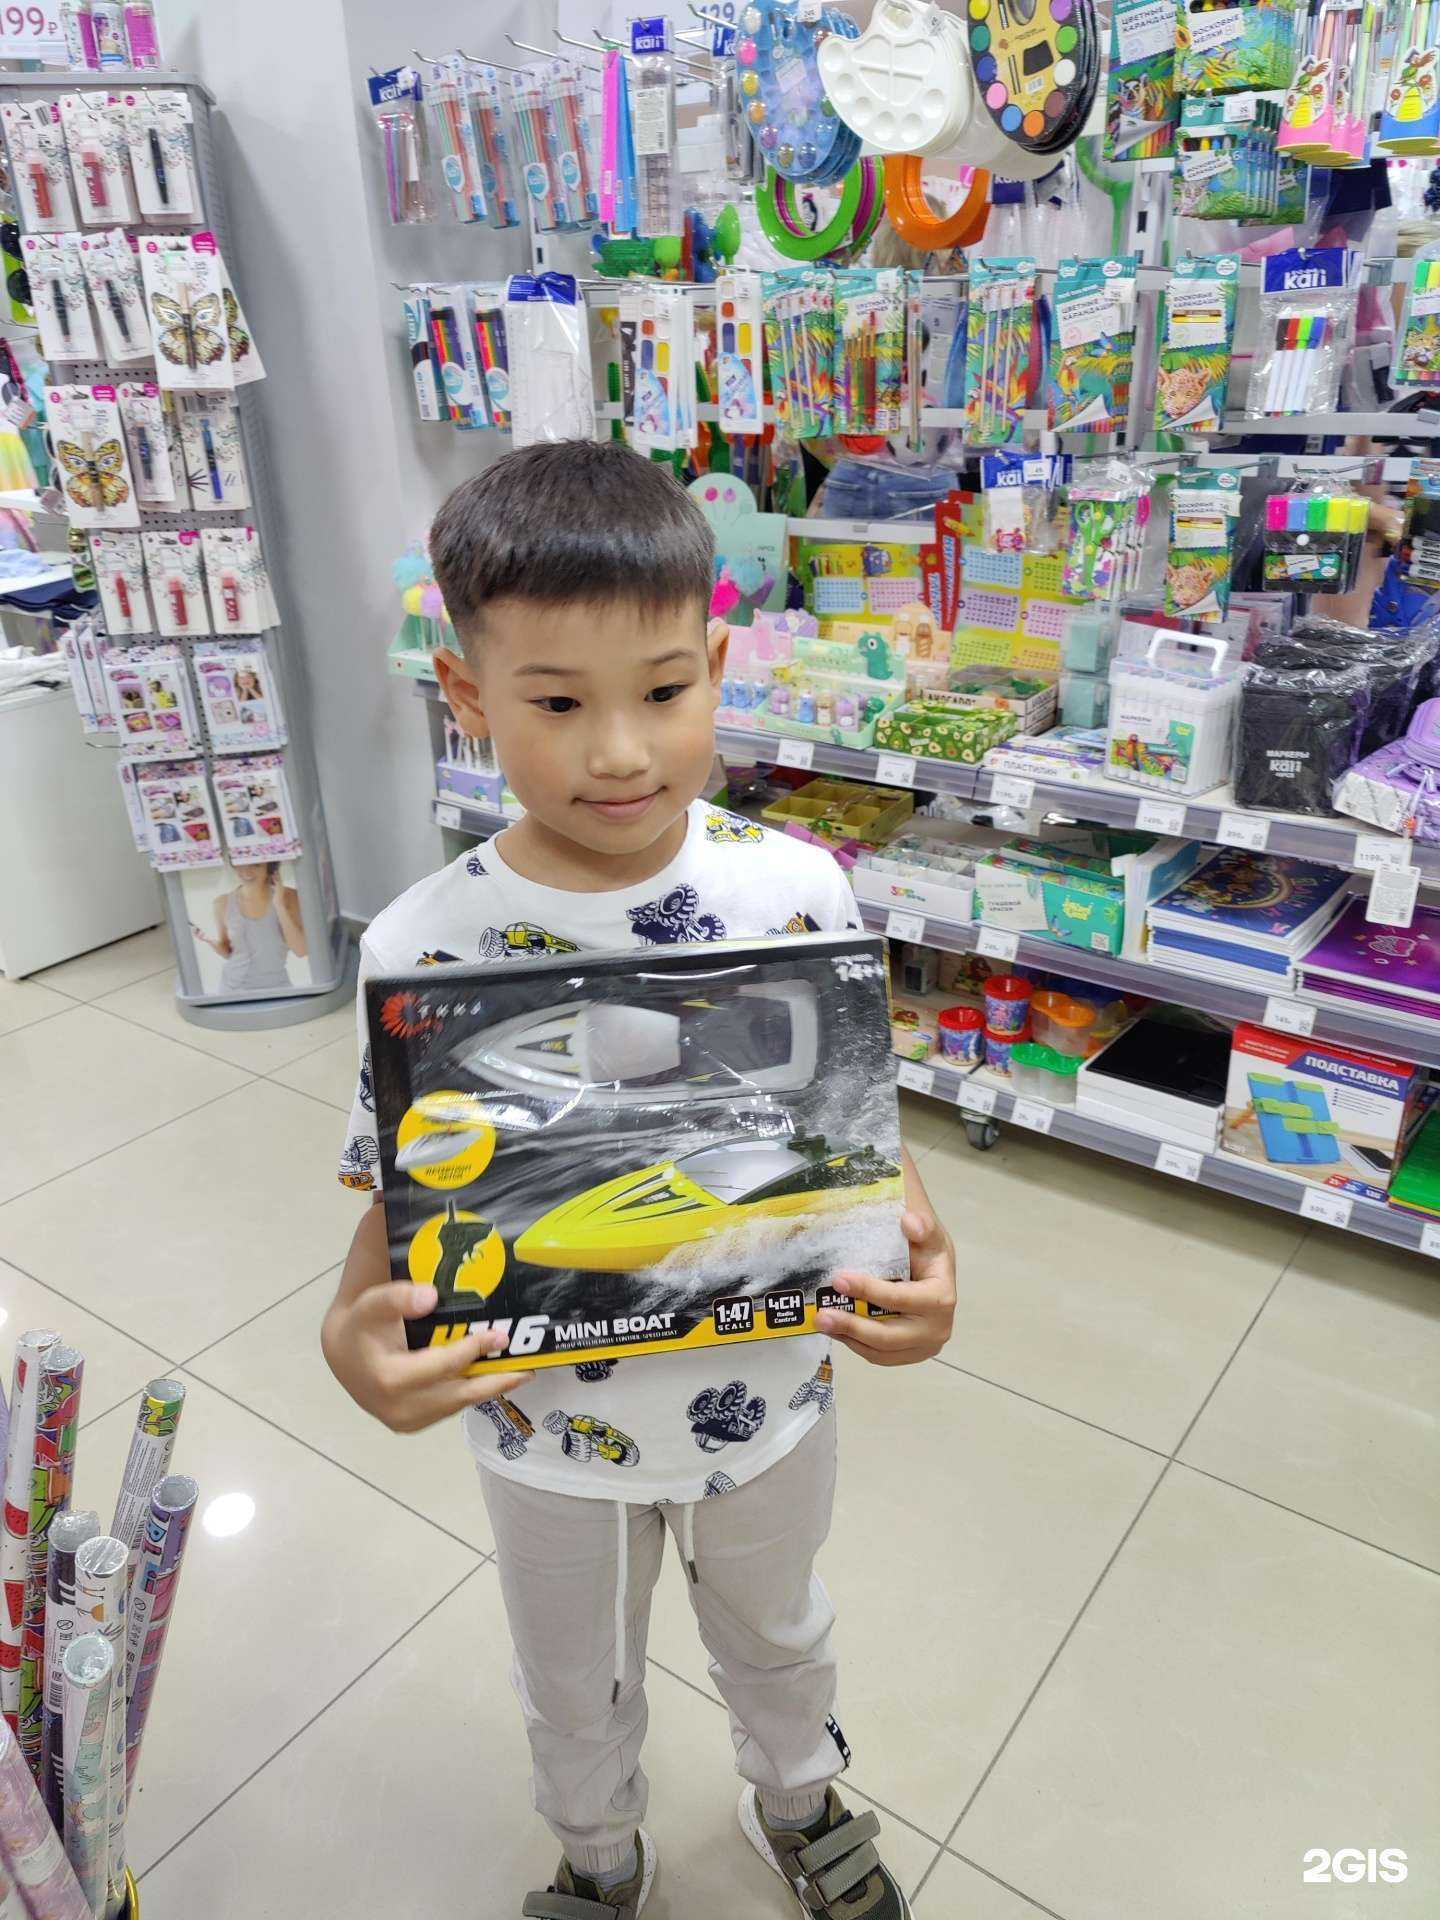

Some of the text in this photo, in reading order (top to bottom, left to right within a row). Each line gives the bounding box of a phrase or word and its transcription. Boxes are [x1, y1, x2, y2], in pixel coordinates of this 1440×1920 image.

[1121, 6, 1164, 25] ЦВЕТНЫЕ
[1123, 11, 1176, 32] КАРАНДАШ
[1193, 14, 1239, 37] ВОСКОВЫЕ
[1284, 268, 1327, 290] kari
[1003, 760, 1057, 777] ПЛАСТИЛИН
[1304, 1055, 1400, 1092] ПОДСТАВКА
[716, 1302, 750, 1324] 1:47
[768, 1295, 801, 1311] 4CH
[554, 1320, 609, 1342] MINI
[613, 1312, 676, 1335] BOAT
[718, 1321, 752, 1331] SCALE
